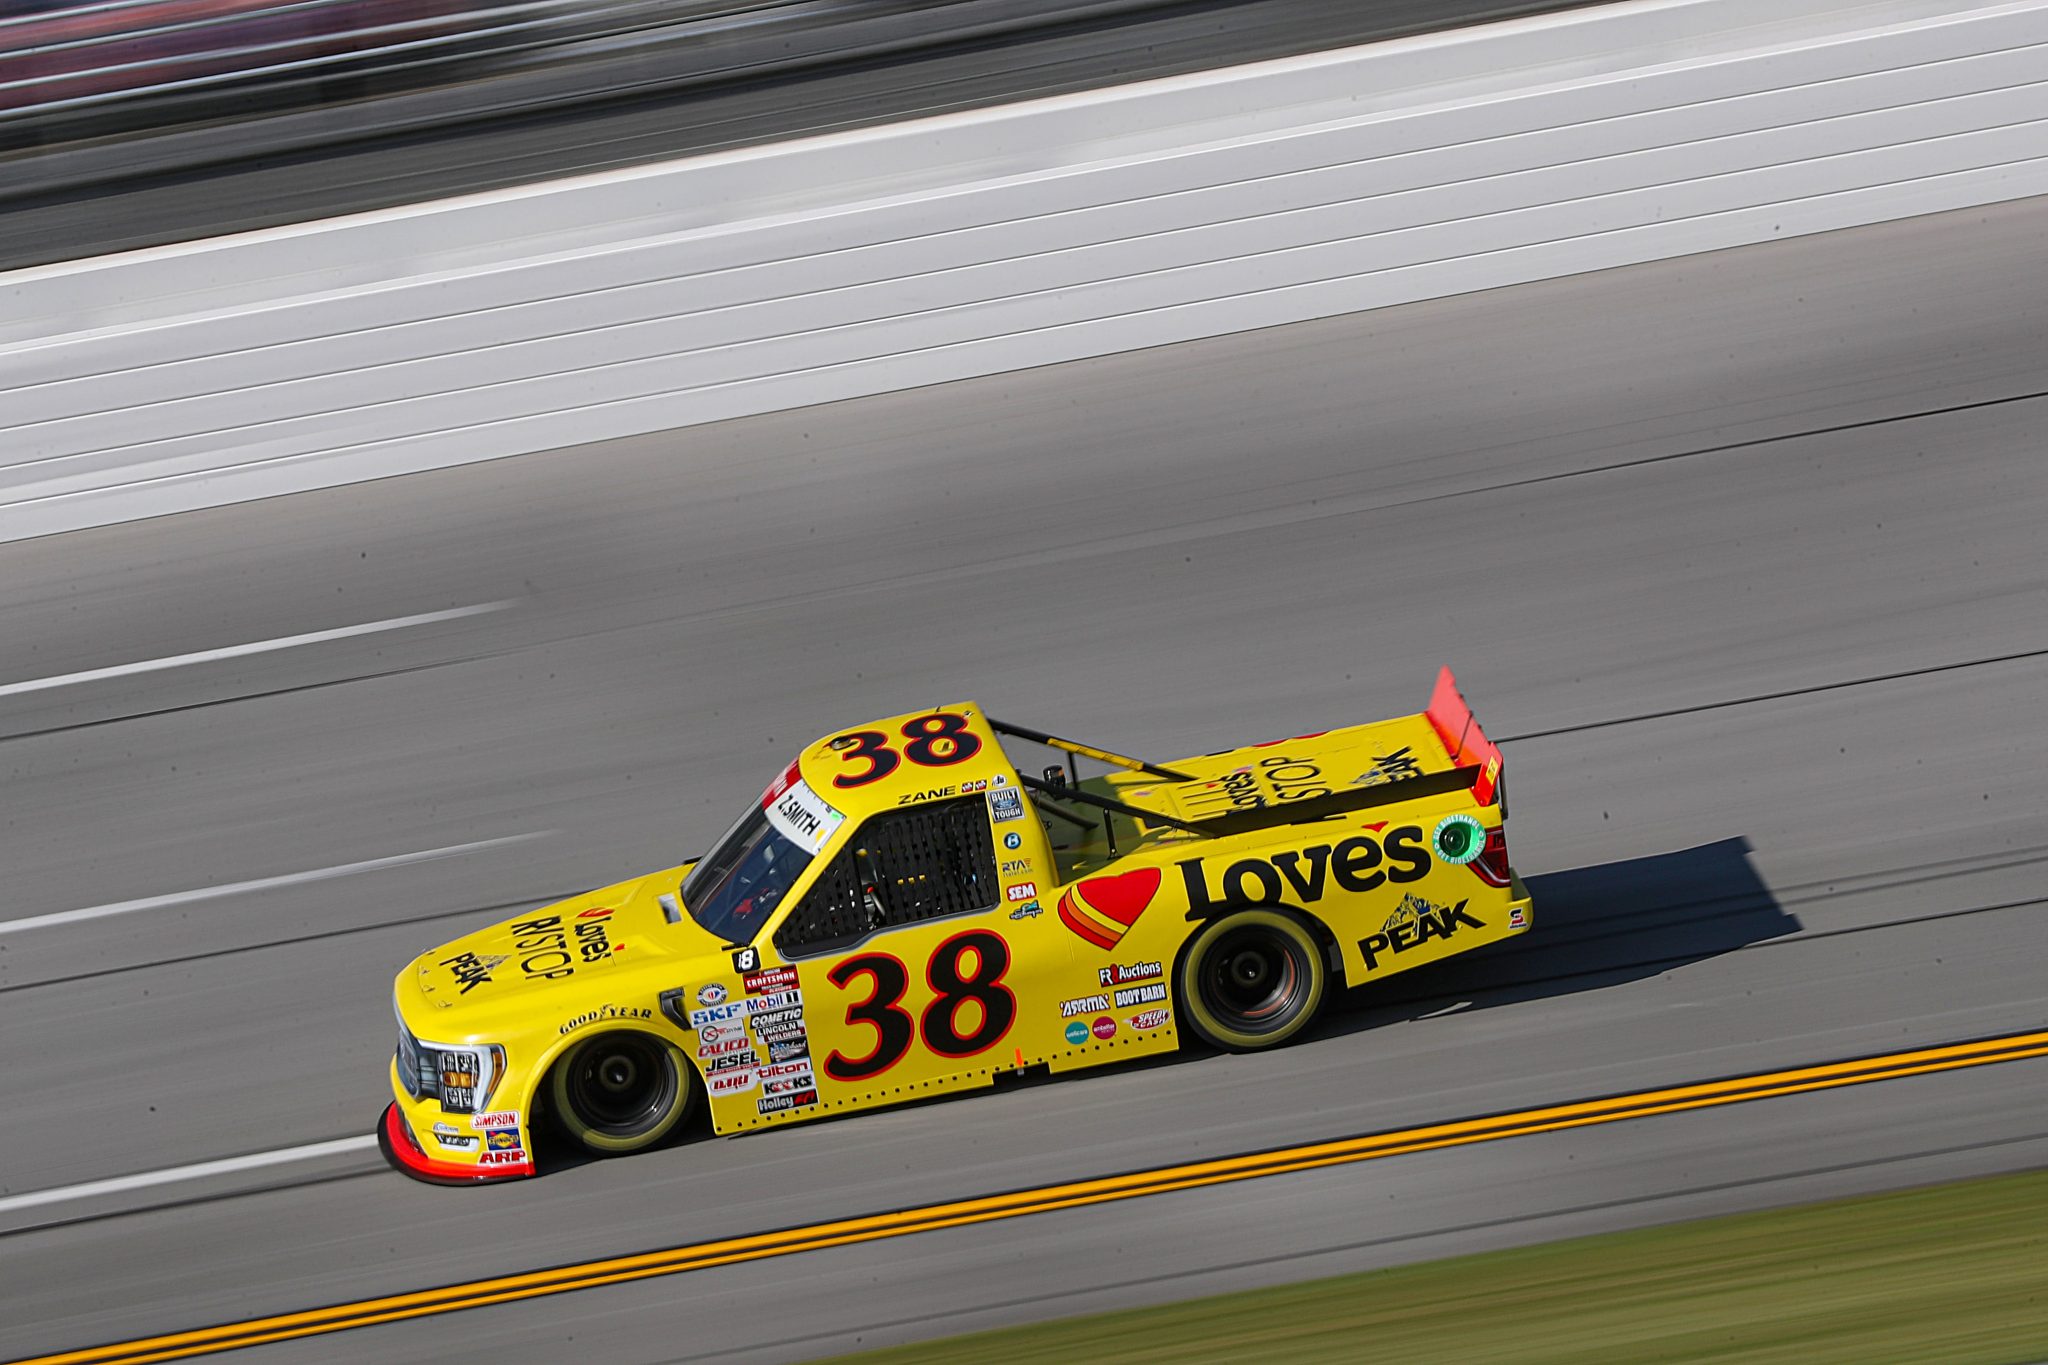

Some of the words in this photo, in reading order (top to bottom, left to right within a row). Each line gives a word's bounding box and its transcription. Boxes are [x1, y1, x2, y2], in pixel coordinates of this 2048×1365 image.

[833, 712, 982, 789] 38
[1371, 746, 1425, 782] EAK
[898, 786, 956, 805] ZANE
[992, 790, 1016, 802] BUILT
[995, 808, 1021, 819] TOUGH
[1002, 860, 1026, 872] RTA
[1008, 884, 1036, 901] SEM
[1357, 898, 1487, 971] PEAK
[439, 952, 492, 995] PEAK
[746, 972, 795, 988] CRAFTSMAN
[746, 994, 783, 1012] Mobil
[1115, 988, 1140, 1006] BOOT
[1140, 984, 1166, 1001] BARN
[693, 1003, 741, 1025] SKF
[823, 928, 1017, 1082] 38
[752, 1008, 802, 1027] COMETIC
[758, 1022, 797, 1036] LINCOLN
[768, 1030, 802, 1041] WELDERS
[706, 1050, 760, 1071] JESEL
[756, 1062, 808, 1078] tilton
[758, 1097, 794, 1111] Holley
[480, 1151, 526, 1163] ARP
